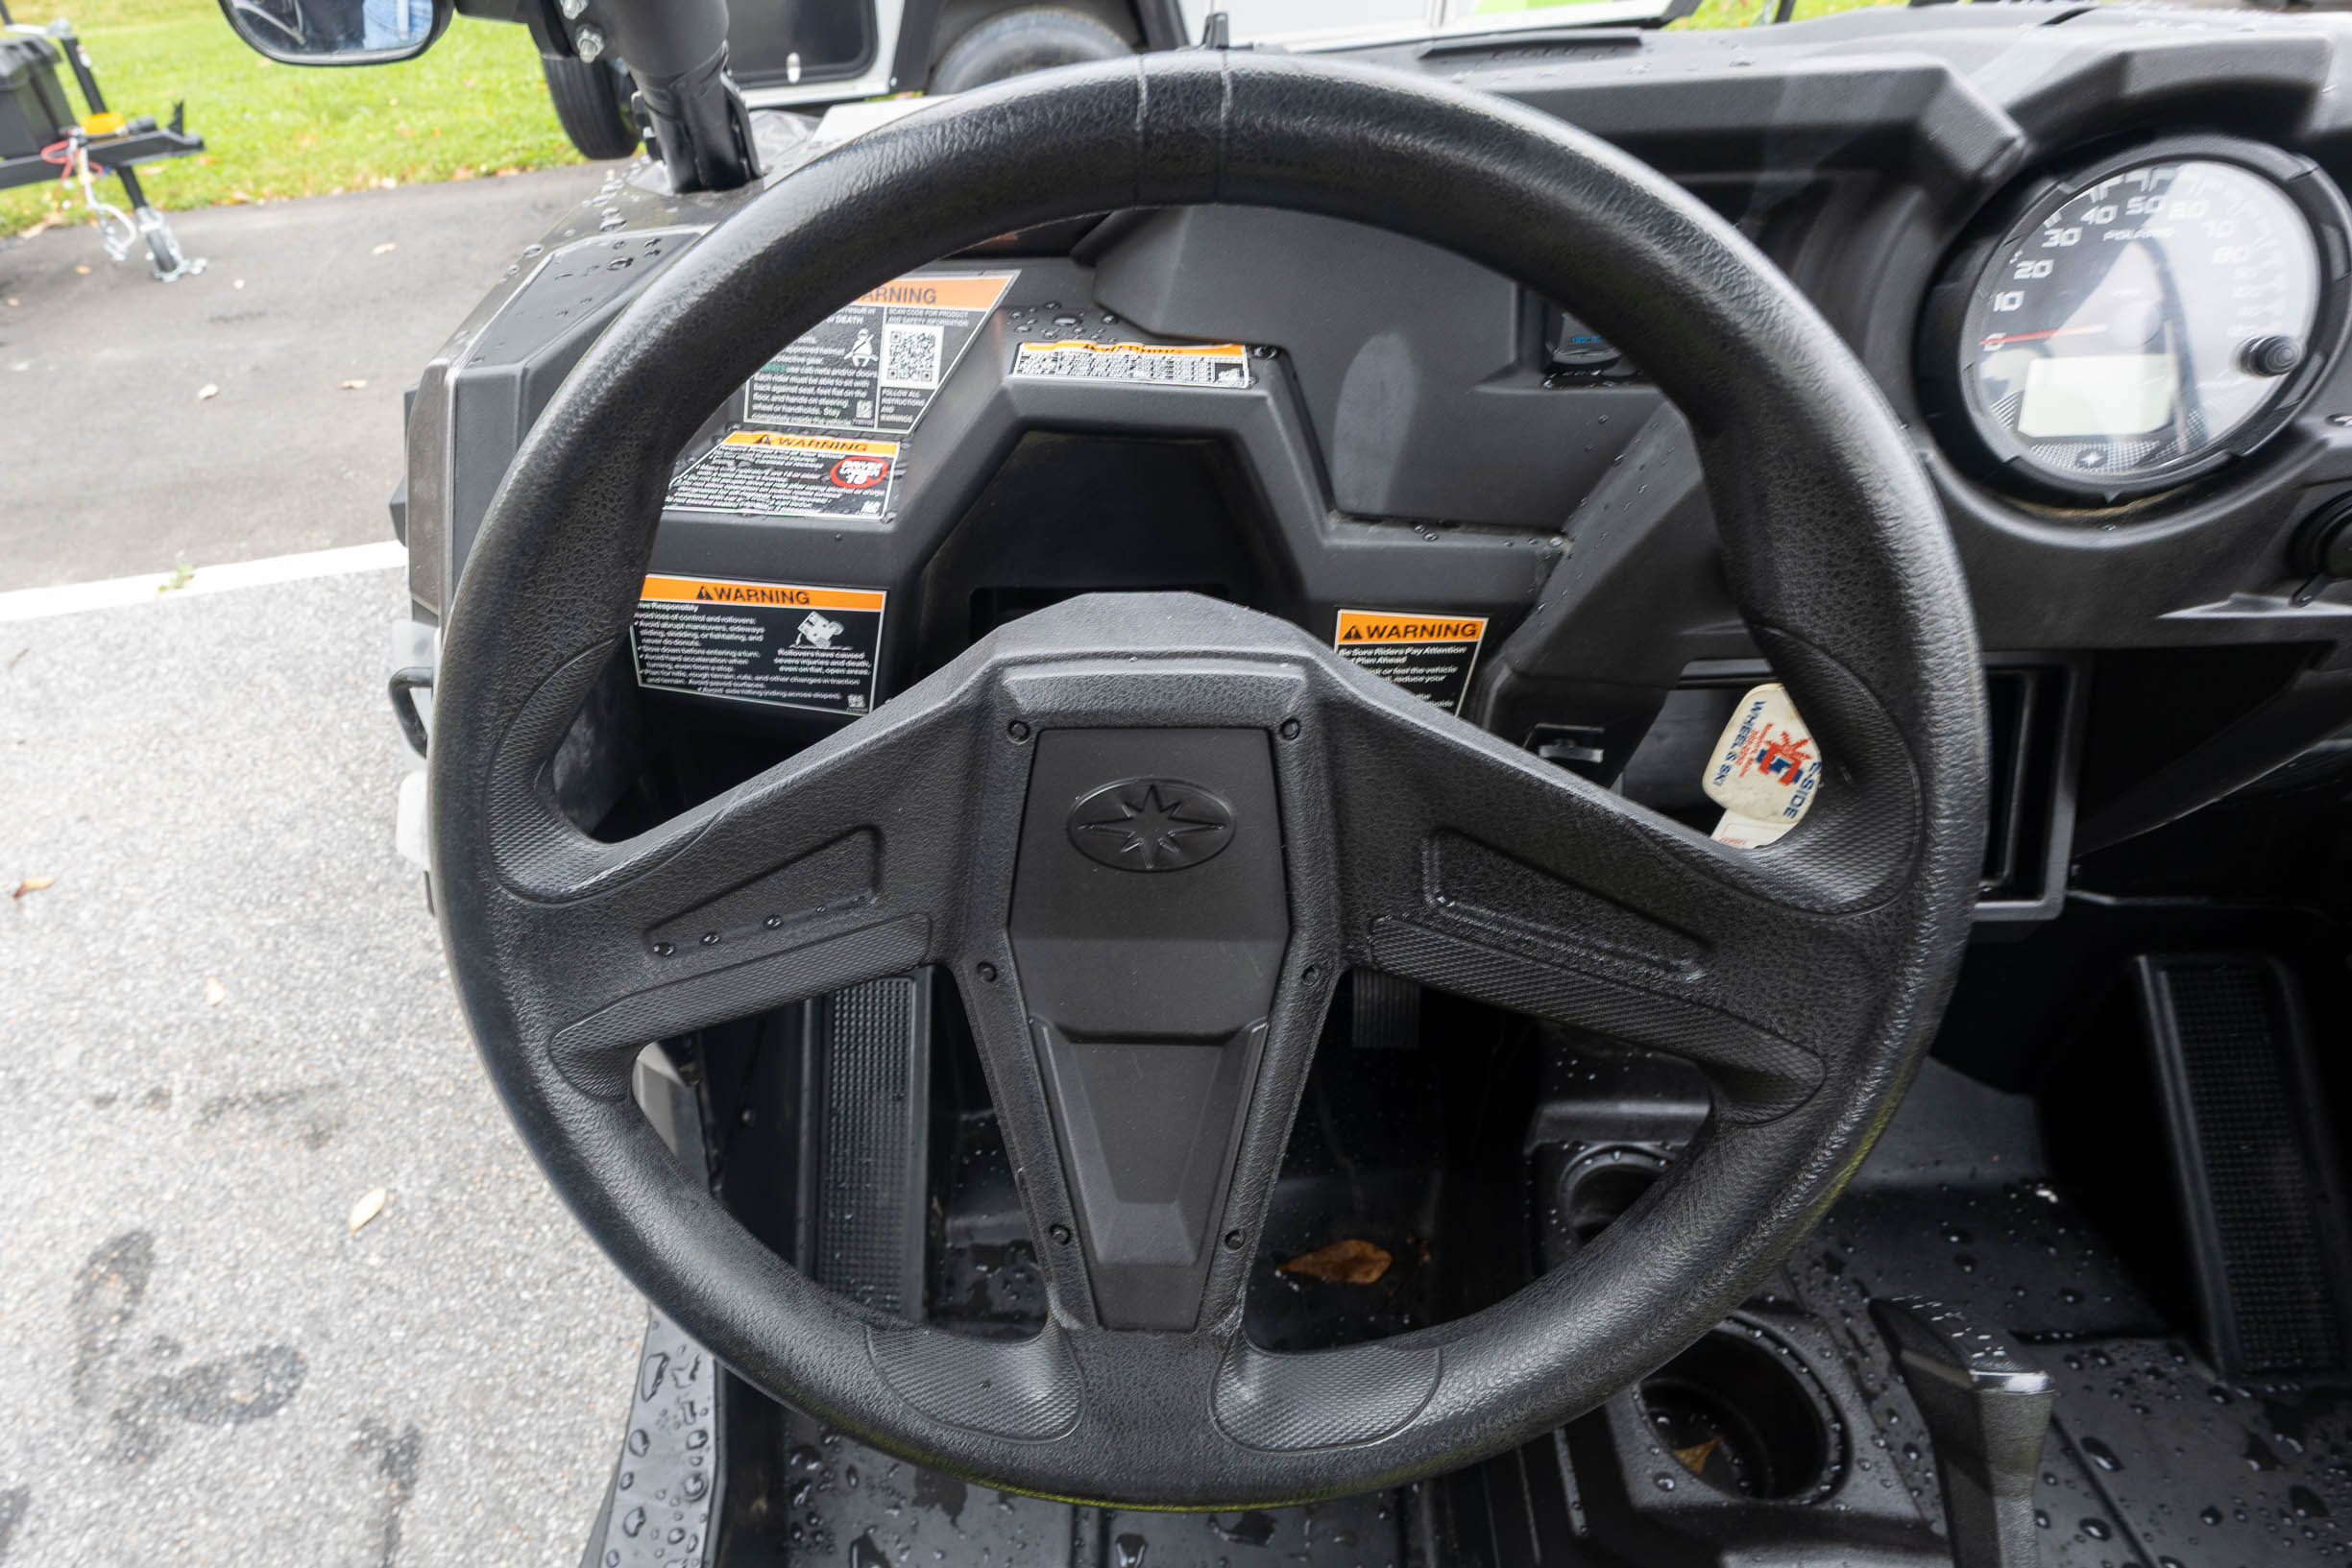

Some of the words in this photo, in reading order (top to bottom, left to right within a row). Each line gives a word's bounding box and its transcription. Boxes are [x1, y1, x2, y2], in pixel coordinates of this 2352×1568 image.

[2125, 195, 2166, 215] 50
[2168, 200, 2209, 221] 60
[2080, 205, 2119, 225] 40
[2042, 227, 2083, 248] 30
[2013, 259, 2054, 279] 20
[862, 286, 937, 304] ARNING
[1993, 291, 2025, 312] 10
[836, 316, 864, 326] DEATH
[831, 368, 855, 376] and/or
[855, 369, 877, 377] doors
[789, 375, 808, 384] must
[853, 379, 870, 388] with
[754, 382, 771, 392] back
[771, 383, 798, 394] against
[816, 386, 831, 395] feet
[855, 390, 867, 398] the
[882, 388, 908, 398] FOLLOW
[771, 393, 783, 401] and
[783, 394, 808, 403] hands
[808, 396, 817, 404] on
[818, 397, 849, 408] steering
[882, 397, 926, 407] INSTRUCTIONS
[752, 402, 773, 411] wheel
[823, 406, 841, 419] Stay
[881, 405, 895, 414] AND
[880, 414, 914, 423] WARNINGS
[778, 437, 868, 452] WARNING
[714, 587, 810, 604] WARNING
[651, 603, 698, 613] Responsibly
[661, 622, 685, 632] abrupt
[729, 625, 765, 635] sideways
[1367, 623, 1477, 639] WARNING
[748, 634, 764, 642] and
[706, 649, 734, 659] entering
[777, 648, 815, 658] Rollovers
[815, 650, 834, 659] have
[835, 651, 865, 660] caused
[1352, 647, 1372, 656] Sure
[1373, 647, 1404, 656] Riders
[1405, 647, 1423, 657] Pay
[1423, 646, 1467, 655] Attention
[683, 656, 726, 664] acceleration
[800, 658, 829, 666] injuries
[1376, 656, 1407, 664] Ahead
[1393, 666, 1410, 675] feel
[1426, 665, 1459, 674] vehicle
[789, 676, 821, 686] changes
[829, 677, 861, 686] traction
[1394, 675, 1425, 684] reduce
[1425, 674, 1446, 685] your
[1731, 700, 1767, 749] WHEEL
[1712, 763, 1732, 787] SKI
